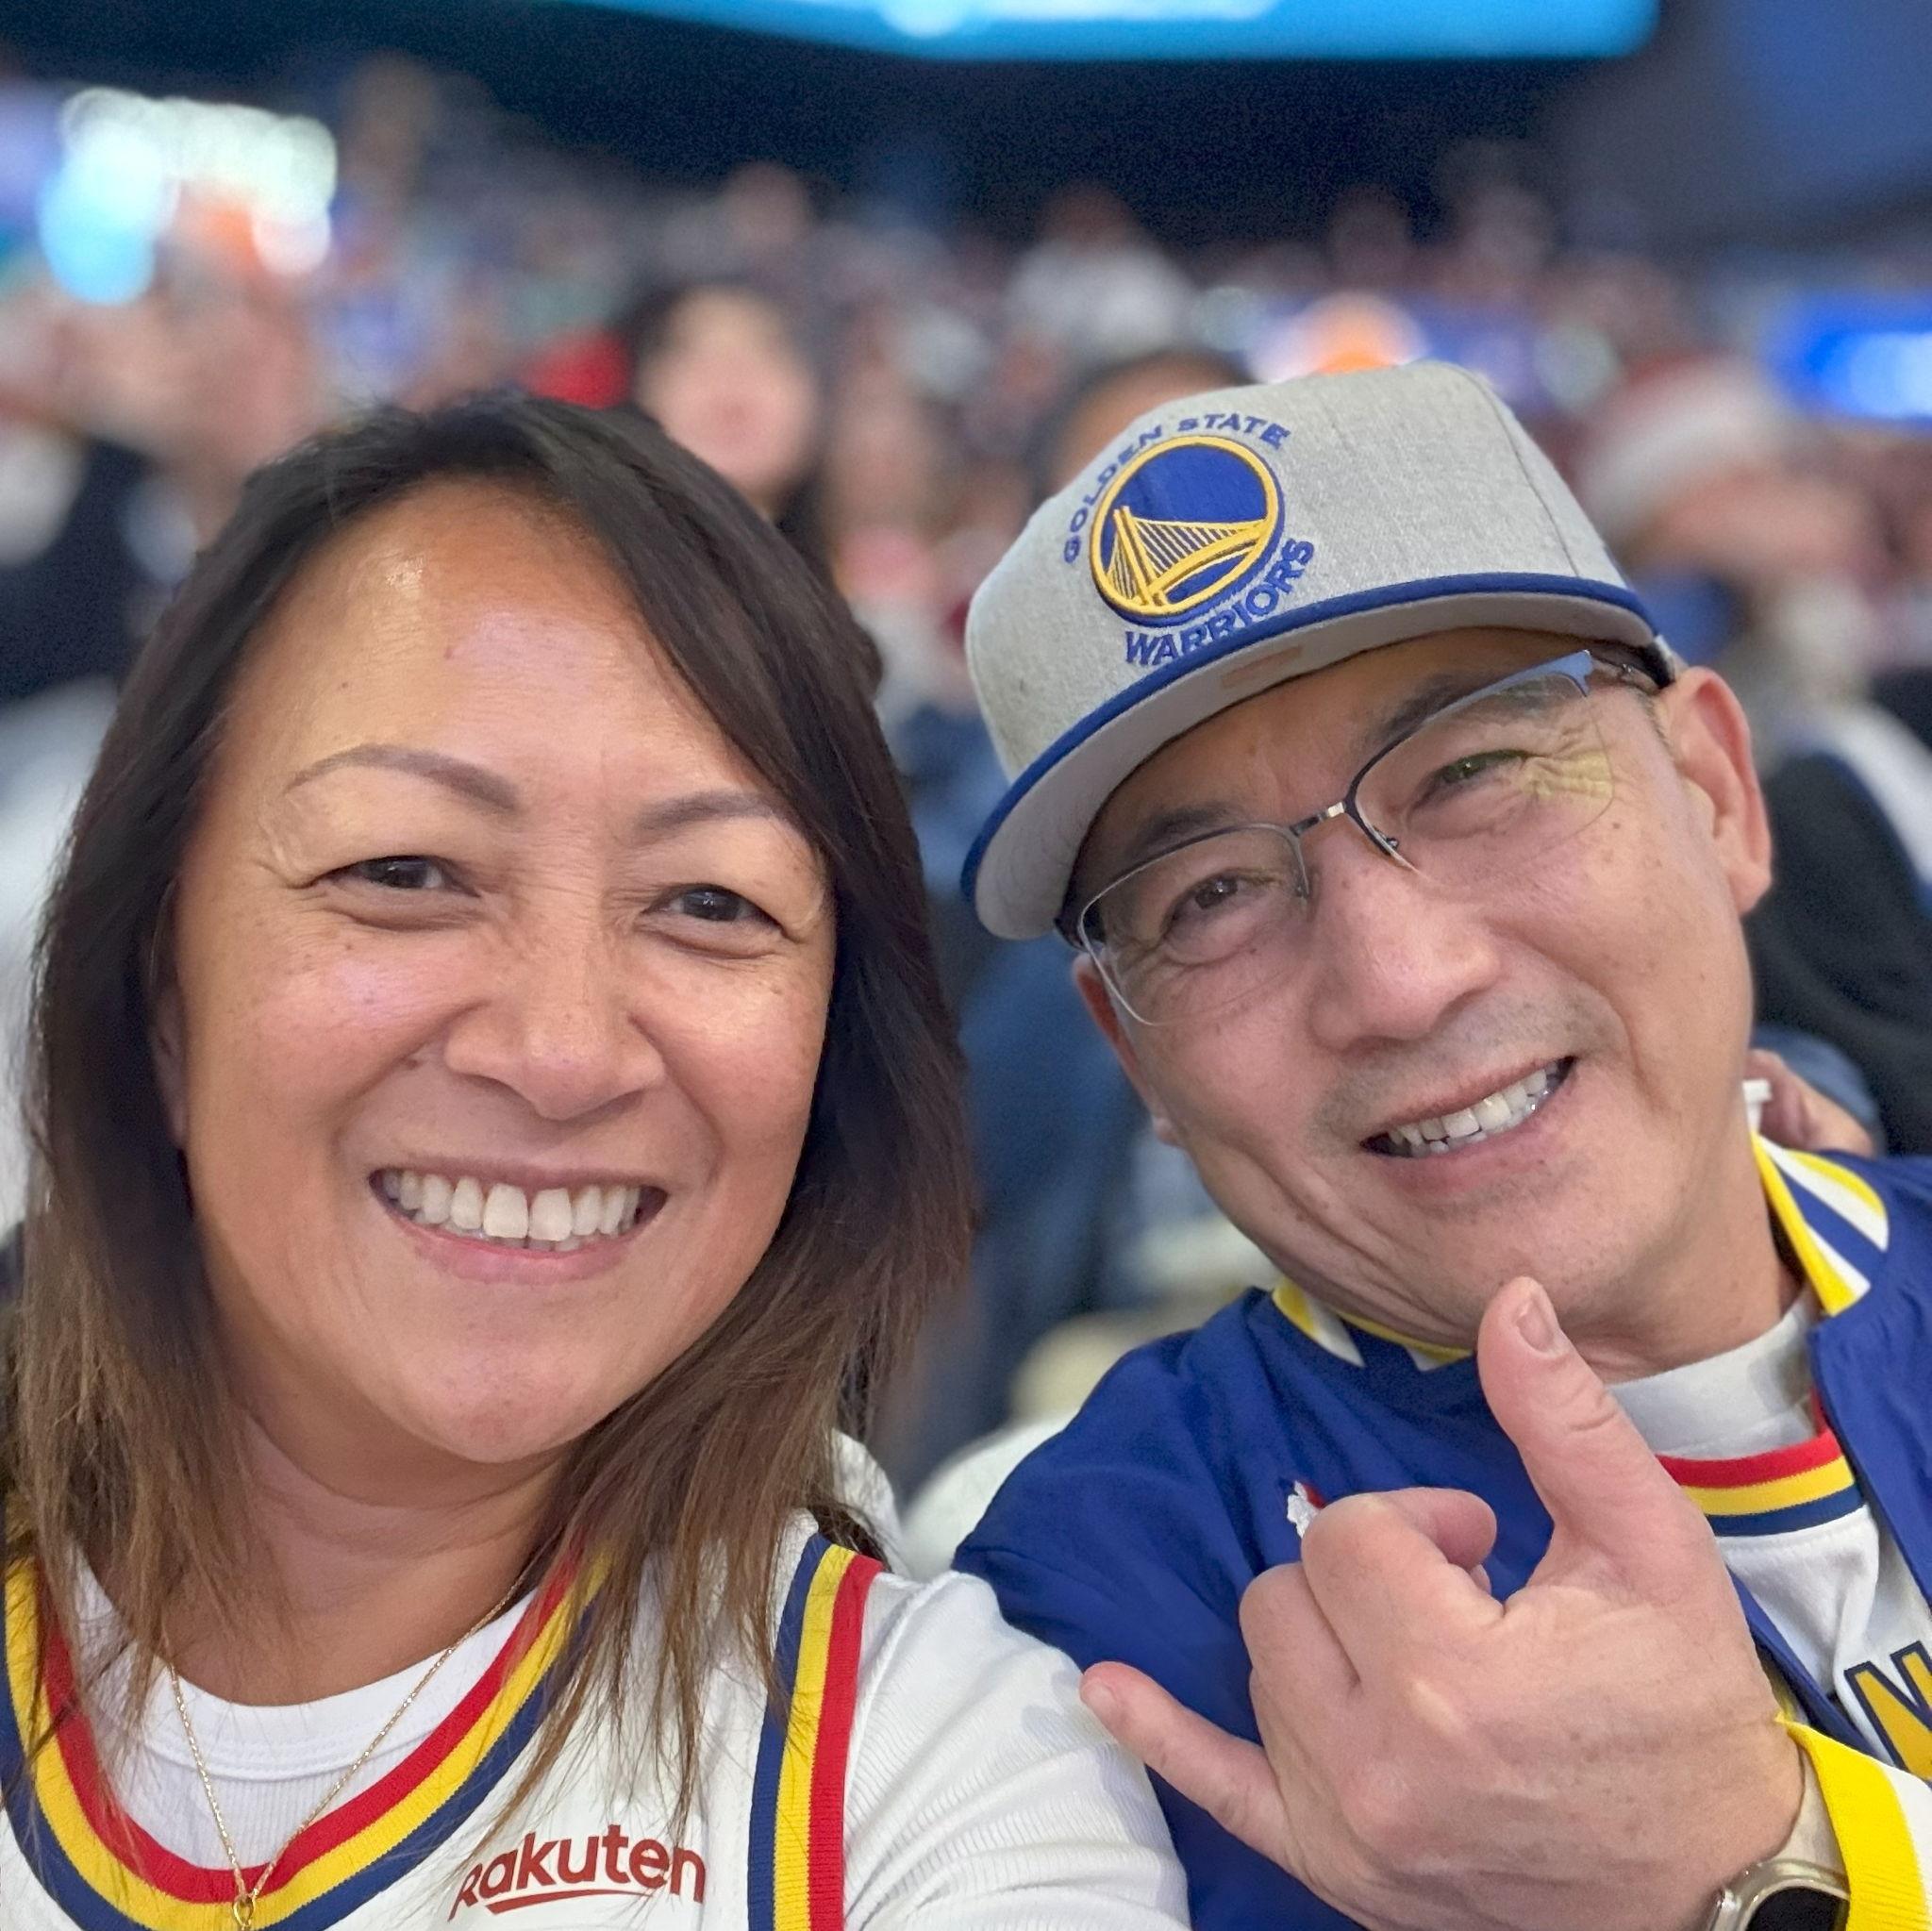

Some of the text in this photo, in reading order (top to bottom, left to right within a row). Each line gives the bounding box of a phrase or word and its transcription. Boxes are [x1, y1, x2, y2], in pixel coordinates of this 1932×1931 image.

[1063, 412, 1291, 564] GOLDEN STATE
[1124, 538, 1315, 665] WARRIORS
[447, 1823, 706, 1923] Rakuten
